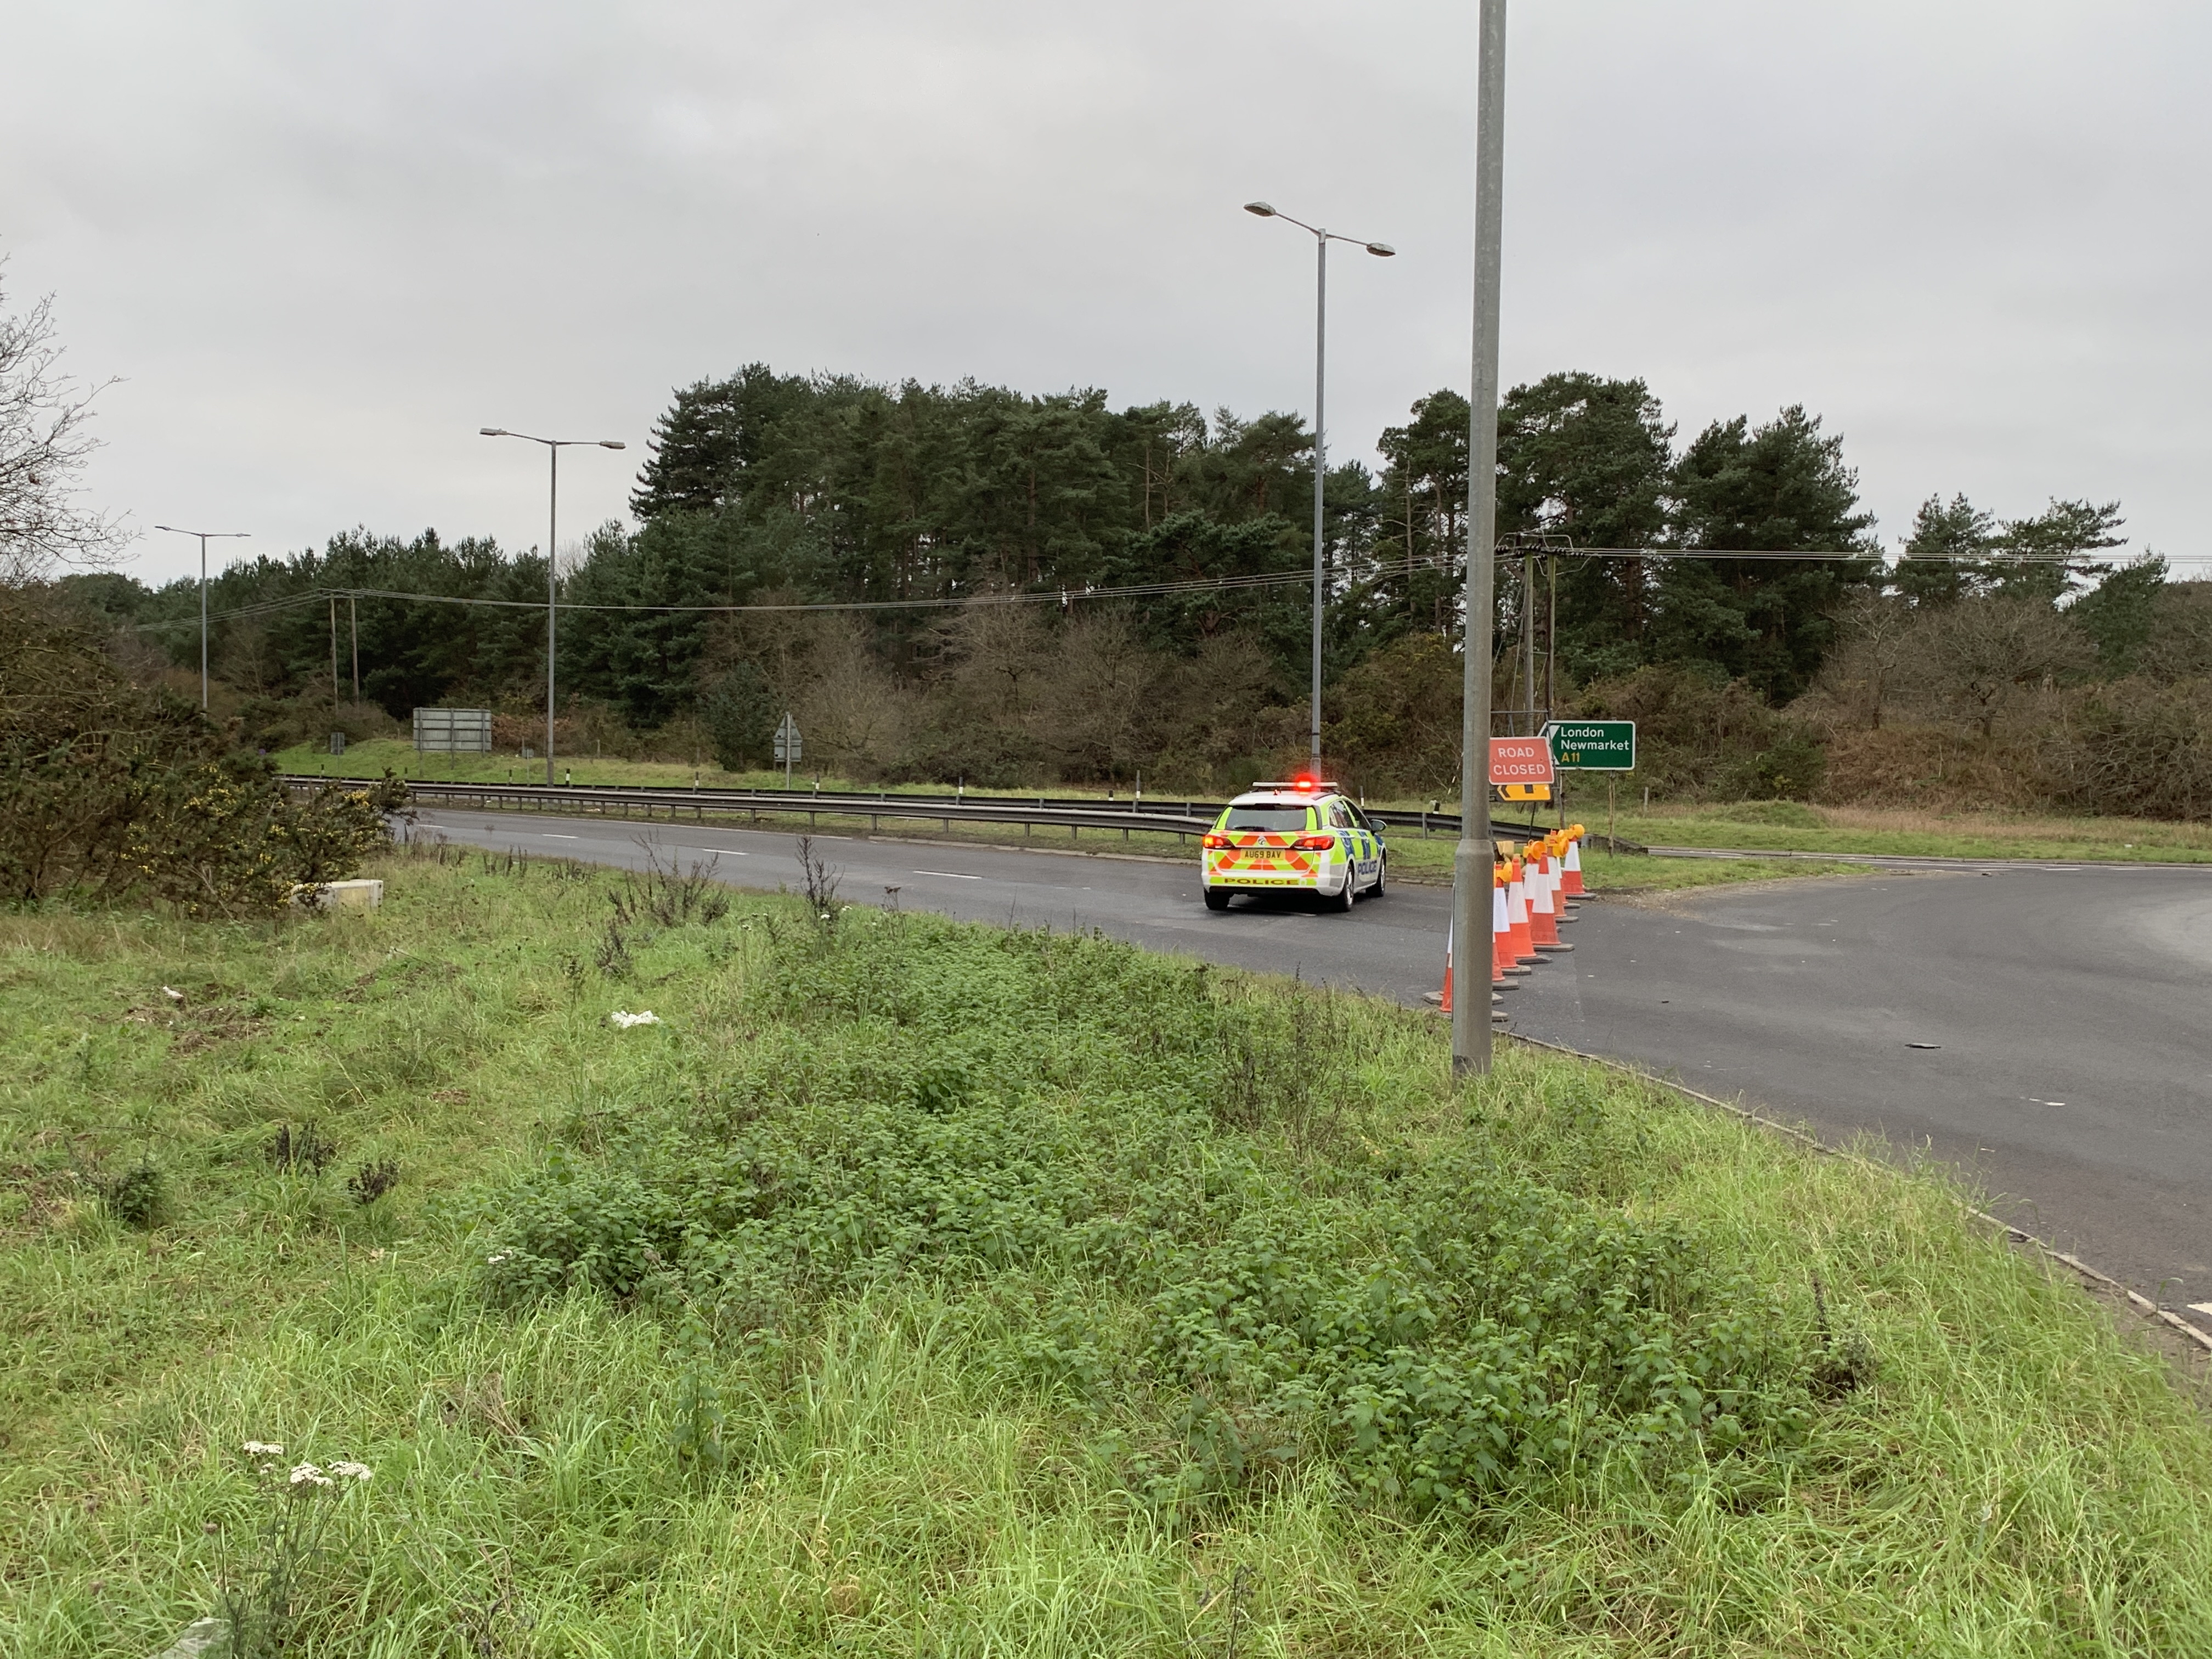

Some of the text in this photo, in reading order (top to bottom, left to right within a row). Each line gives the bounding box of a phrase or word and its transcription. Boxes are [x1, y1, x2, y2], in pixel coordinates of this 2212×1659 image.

[1561, 727, 1604, 737] London
[1561, 740, 1629, 751] Newmarket
[1498, 747, 1534, 758] ROAD
[1561, 752, 1580, 763] A11
[1493, 764, 1545, 775] CLOSED
[1358, 860, 1378, 875] POLICE
